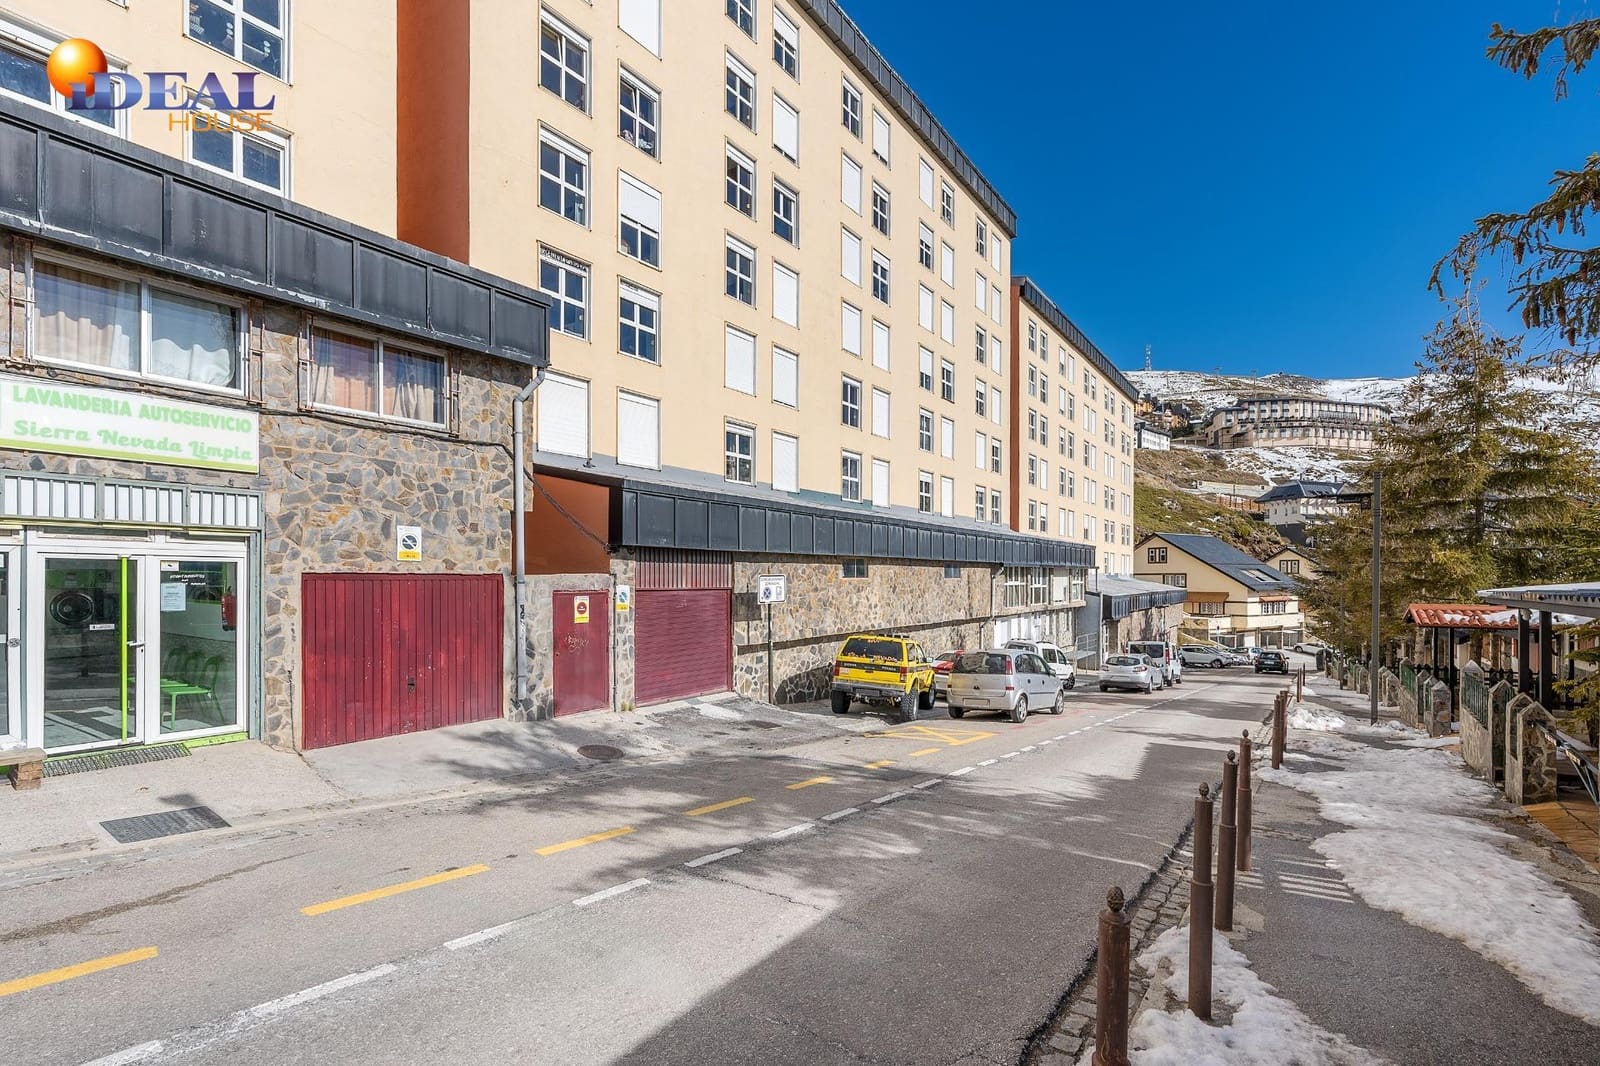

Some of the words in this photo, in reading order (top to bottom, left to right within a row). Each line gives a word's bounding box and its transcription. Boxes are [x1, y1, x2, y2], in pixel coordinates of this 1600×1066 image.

[12, 384, 132, 418] LAVANDERIA
[138, 403, 252, 433] AUTOSERVICIO
[13, 419, 91, 442] Sierra
[97, 428, 183, 453] Nevada
[188, 440, 252, 463] Limpia
